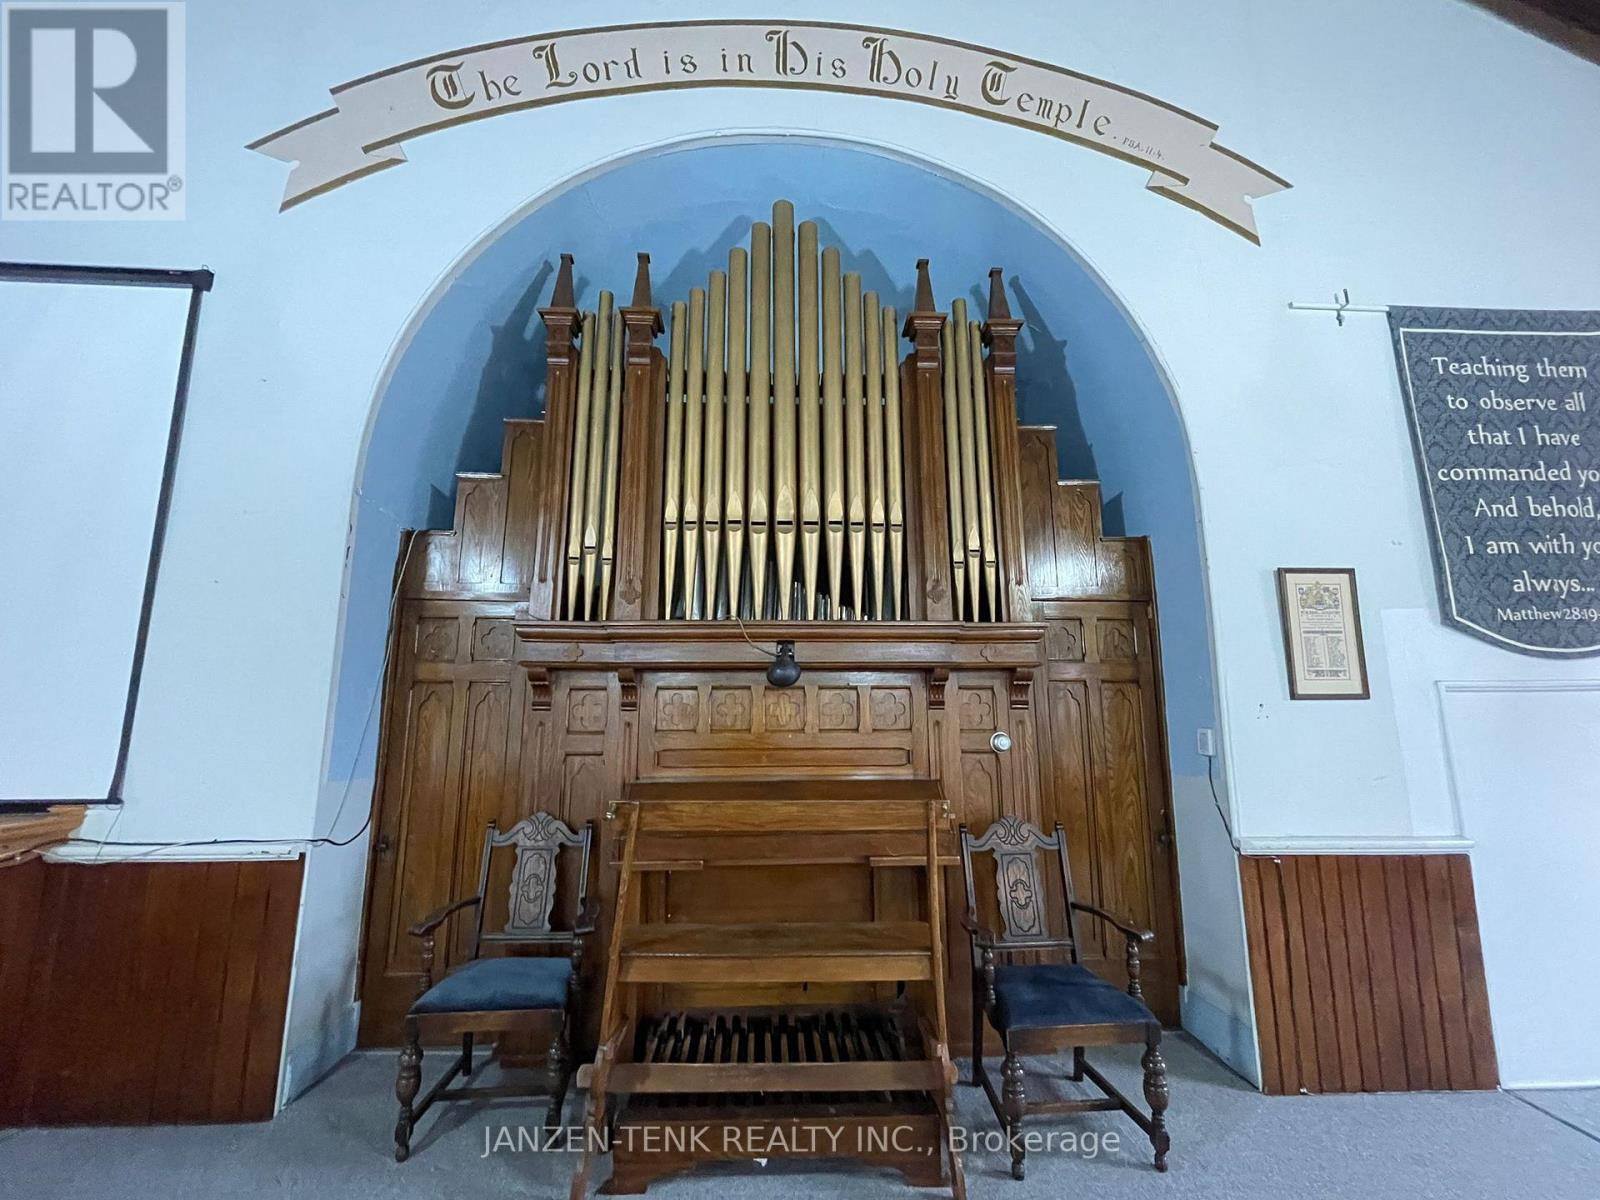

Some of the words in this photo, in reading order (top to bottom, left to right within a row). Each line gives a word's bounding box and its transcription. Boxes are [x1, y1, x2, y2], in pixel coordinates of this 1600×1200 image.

[426, 60, 522, 110] The
[532, 42, 643, 90] Lord
[663, 49, 698, 75] is
[721, 47, 754, 74] in
[764, 29, 847, 79] His
[861, 36, 960, 100] Holy
[980, 60, 1117, 140] Temple.
[1431, 356, 1530, 383] Teaching
[1536, 358, 1588, 379] them
[1446, 394, 1469, 410] to
[1479, 390, 1558, 411] observe
[1565, 392, 1587, 413] all
[1466, 424, 1513, 446] that
[1517, 426, 1527, 446] I
[1533, 425, 1582, 447] have
[1437, 460, 1572, 482] commanded
[1474, 497, 1519, 518] And
[1464, 535, 1475, 555] I
[1486, 541, 1520, 555] am
[1528, 532, 1575, 555] with
[1497, 606, 1562, 622] Matthew
